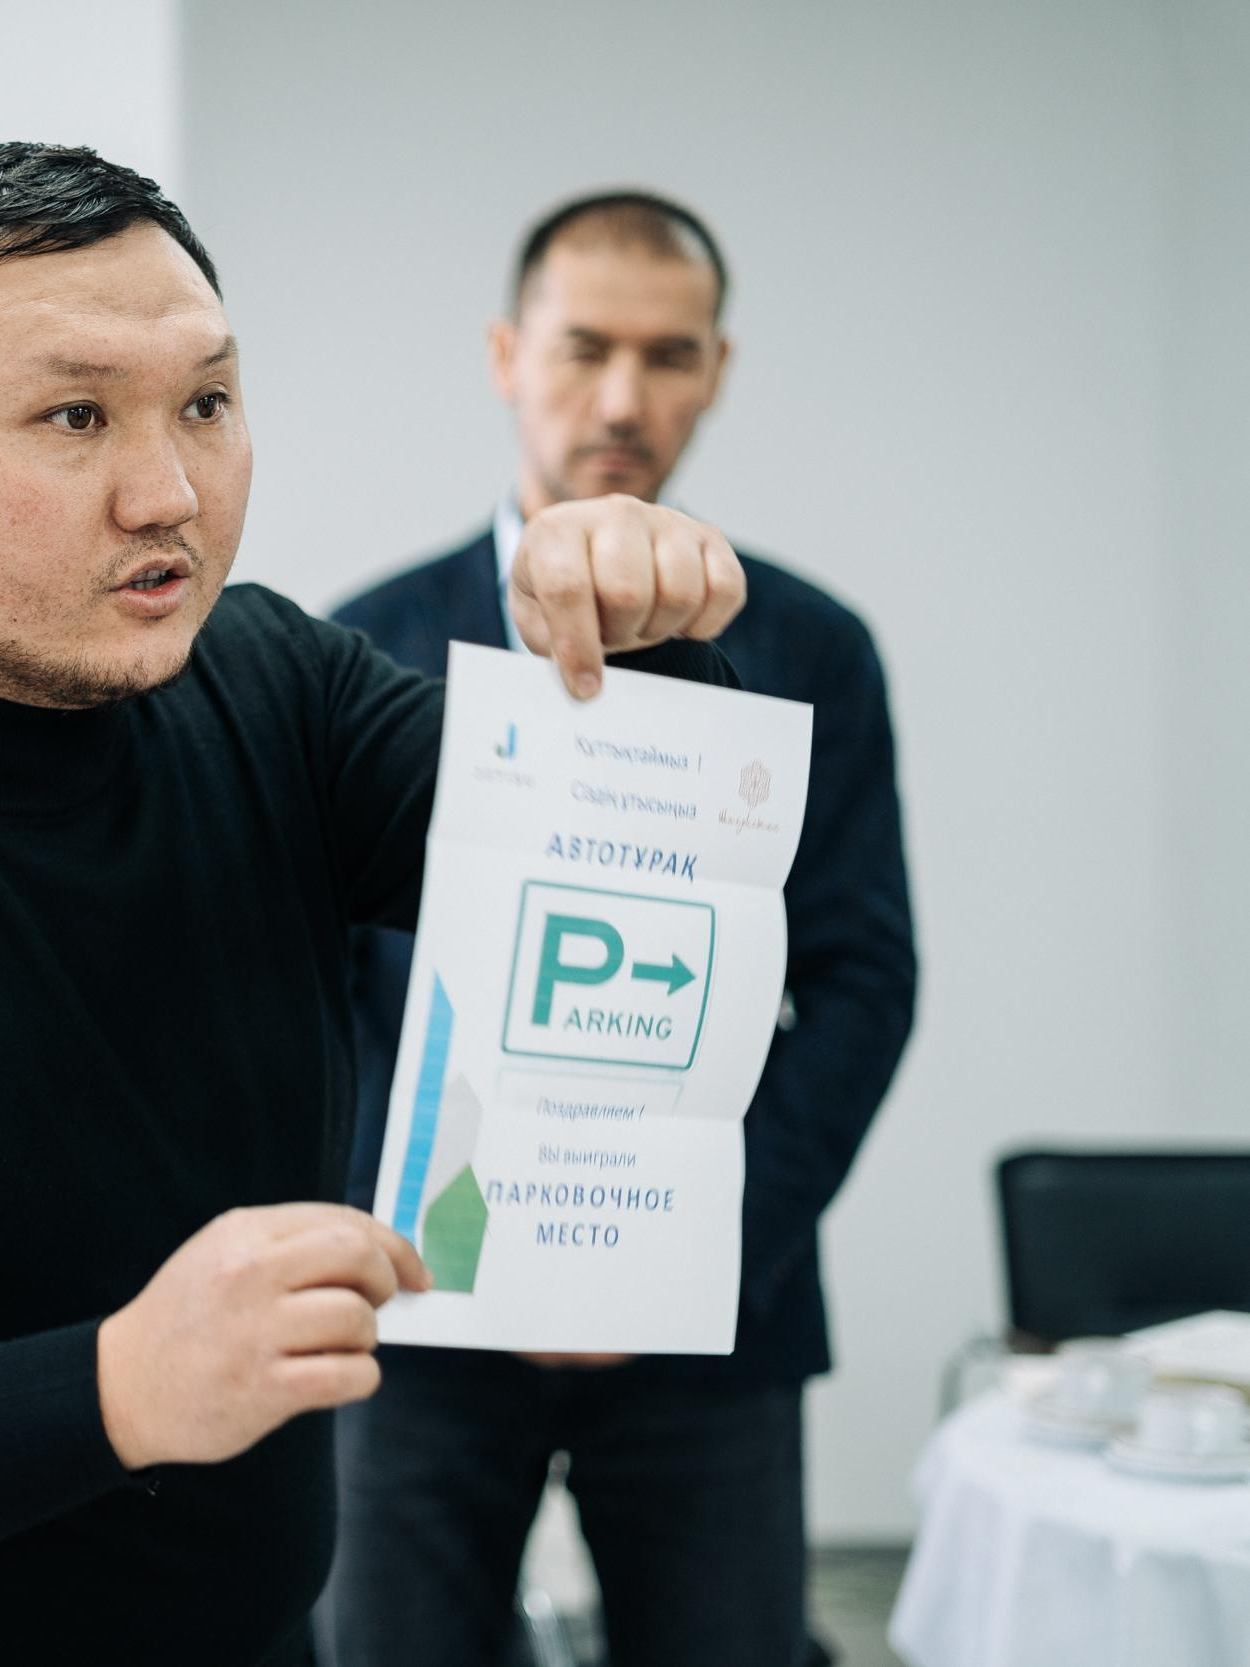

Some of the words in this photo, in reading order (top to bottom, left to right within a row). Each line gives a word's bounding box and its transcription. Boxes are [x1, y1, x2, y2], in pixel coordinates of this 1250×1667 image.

[564, 1148, 636, 1170] выиграли
[486, 1181, 674, 1212] ПАРКОВОЧНОЕ
[536, 1223, 619, 1247] МЕСТО
